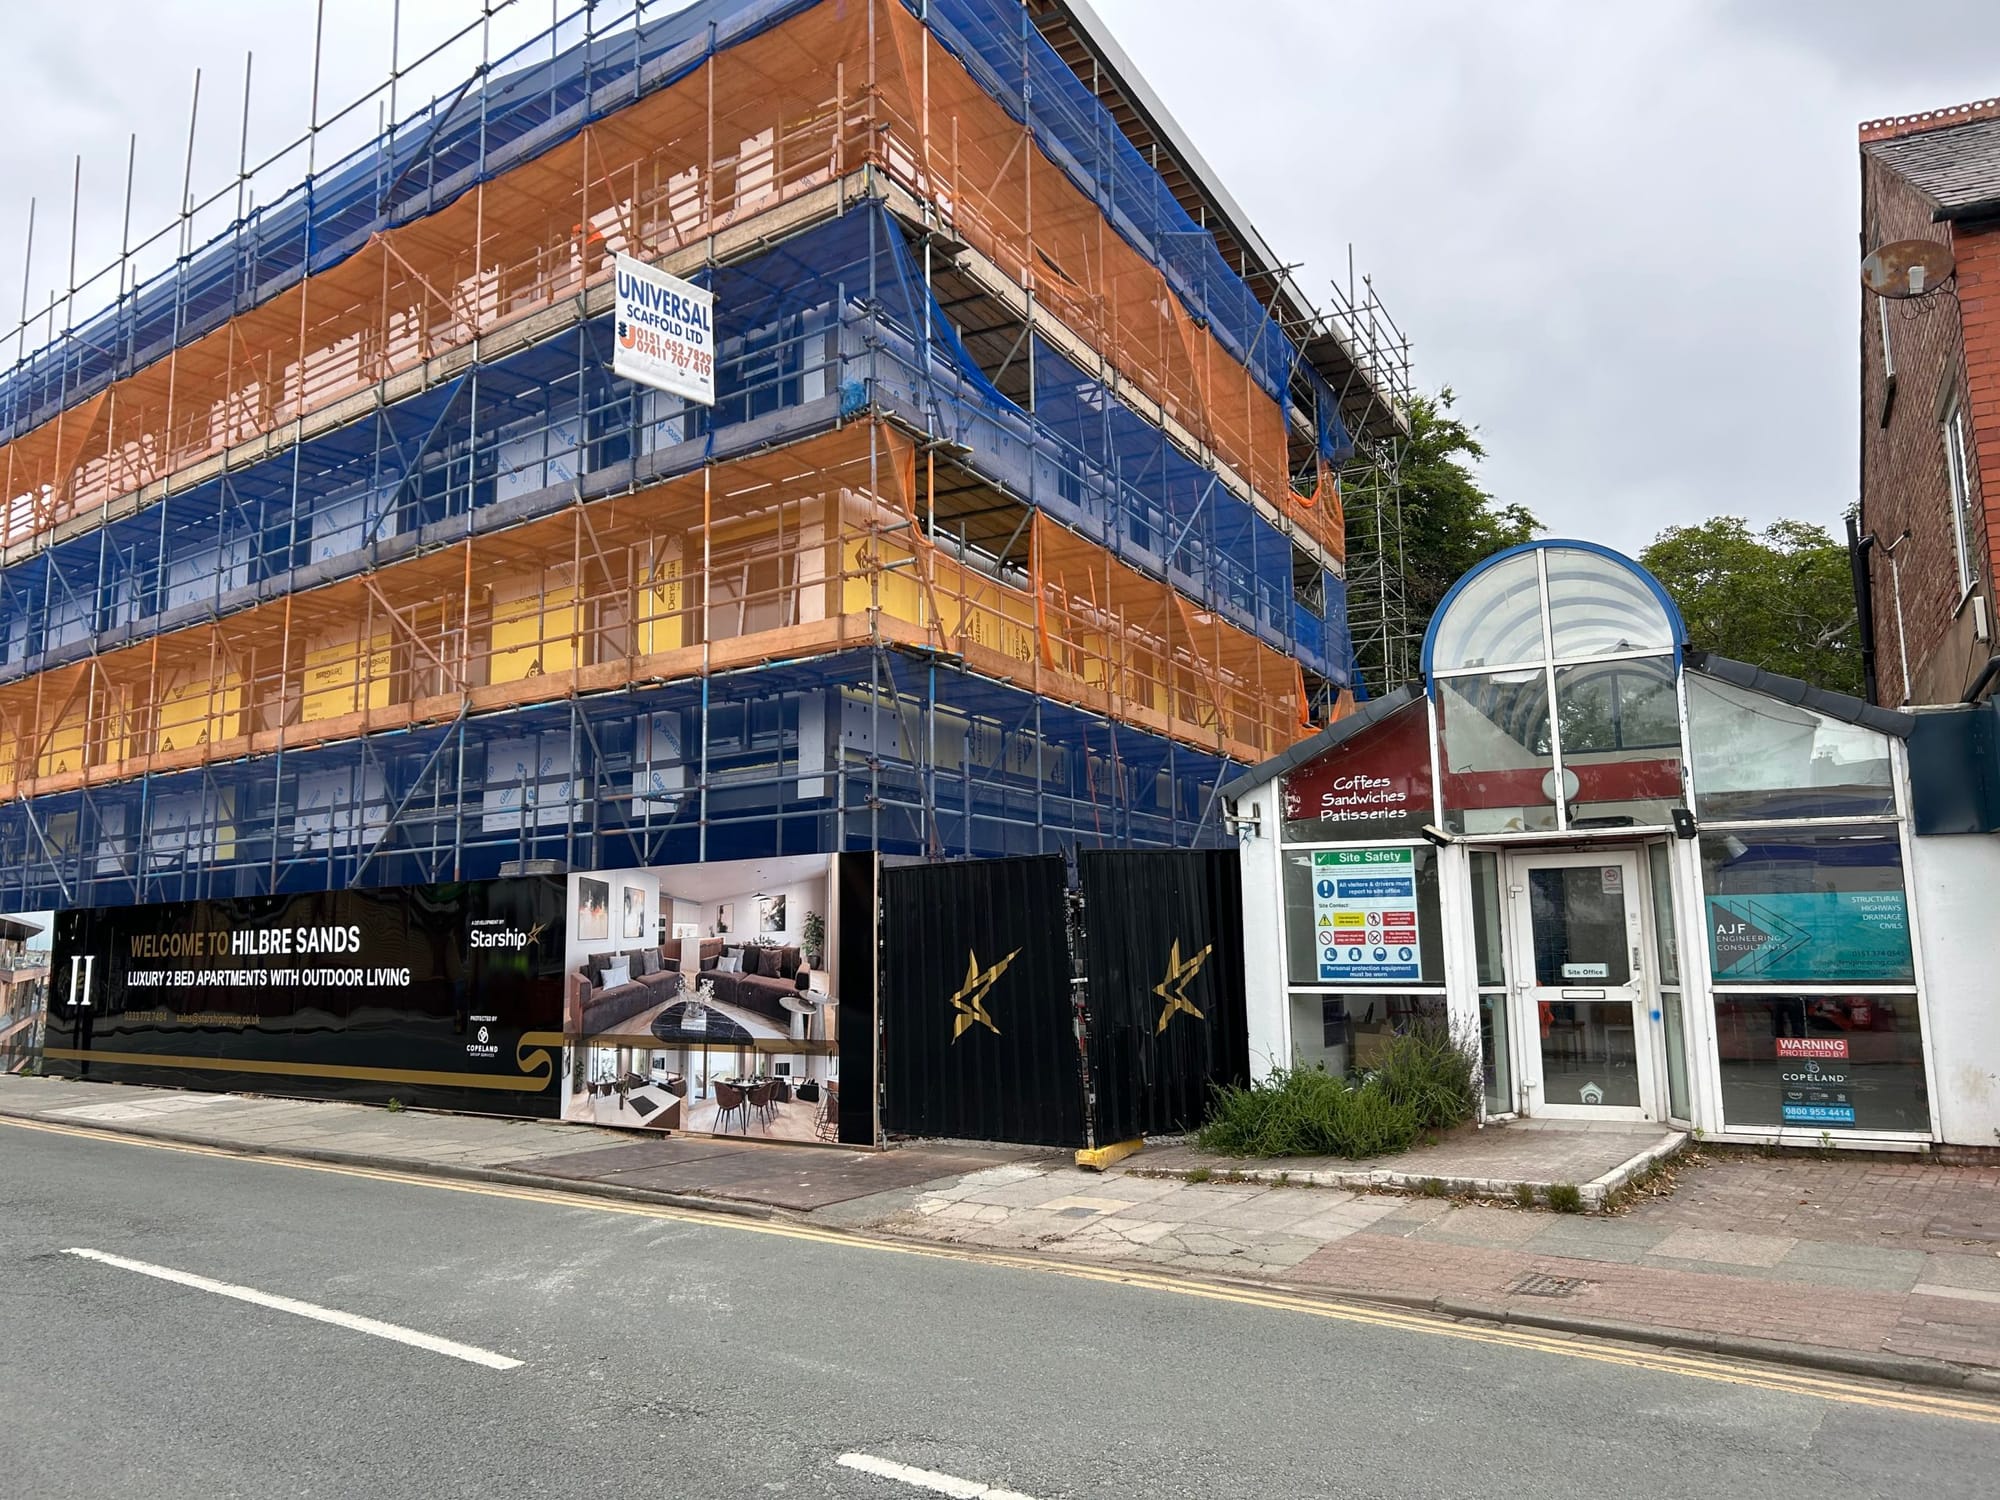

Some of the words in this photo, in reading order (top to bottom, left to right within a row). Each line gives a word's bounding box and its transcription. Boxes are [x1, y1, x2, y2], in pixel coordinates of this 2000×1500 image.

[618, 270, 710, 332] UNIVERSAL
[626, 304, 683, 337] SCAFFOLD
[685, 328, 704, 345] LTD
[636, 328, 660, 346] 0151
[664, 338, 684, 355] 652
[688, 347, 712, 365] 7829
[636, 340, 668, 361] 07411
[671, 353, 690, 369] 707
[693, 362, 711, 377] 419
[1333, 775, 1391, 791] Coffees
[1321, 790, 1406, 807] Sandwiches
[1320, 807, 1407, 822] Patisseries
[1339, 852, 1360, 863] Site
[1364, 851, 1401, 864] Safety
[1851, 895, 1899, 904] STRUCTURAL
[1861, 904, 1902, 912] HIGHWAYS
[1862, 913, 1902, 921] DRAINAGE
[1717, 923, 1746, 935] AJF
[131, 932, 204, 958] WELCOME
[208, 931, 229, 956] TO
[231, 928, 293, 956] HILBRE
[296, 925, 361, 953] SANDS
[470, 927, 527, 951] Starship
[1716, 934, 1781, 943] ENGINEERING
[1717, 943, 1788, 951] CONSULTANTS
[127, 970, 166, 986] LUXURY
[166, 970, 173, 986] 2
[174, 970, 195, 986] BED
[196, 969, 268, 986] APARTMENTS
[270, 969, 299, 986] WITH
[302, 968, 363, 986] OUTDOOR
[366, 967, 410, 987] LIVING
[466, 1044, 499, 1053] COPELAND
[1780, 1040, 1845, 1050] WARNING
[1780, 1049, 1832, 1057] PROTECTED
[1785, 1107, 1807, 1115] 0800
[1809, 1108, 1826, 1116] 955
[1828, 1108, 1851, 1117] 4414
